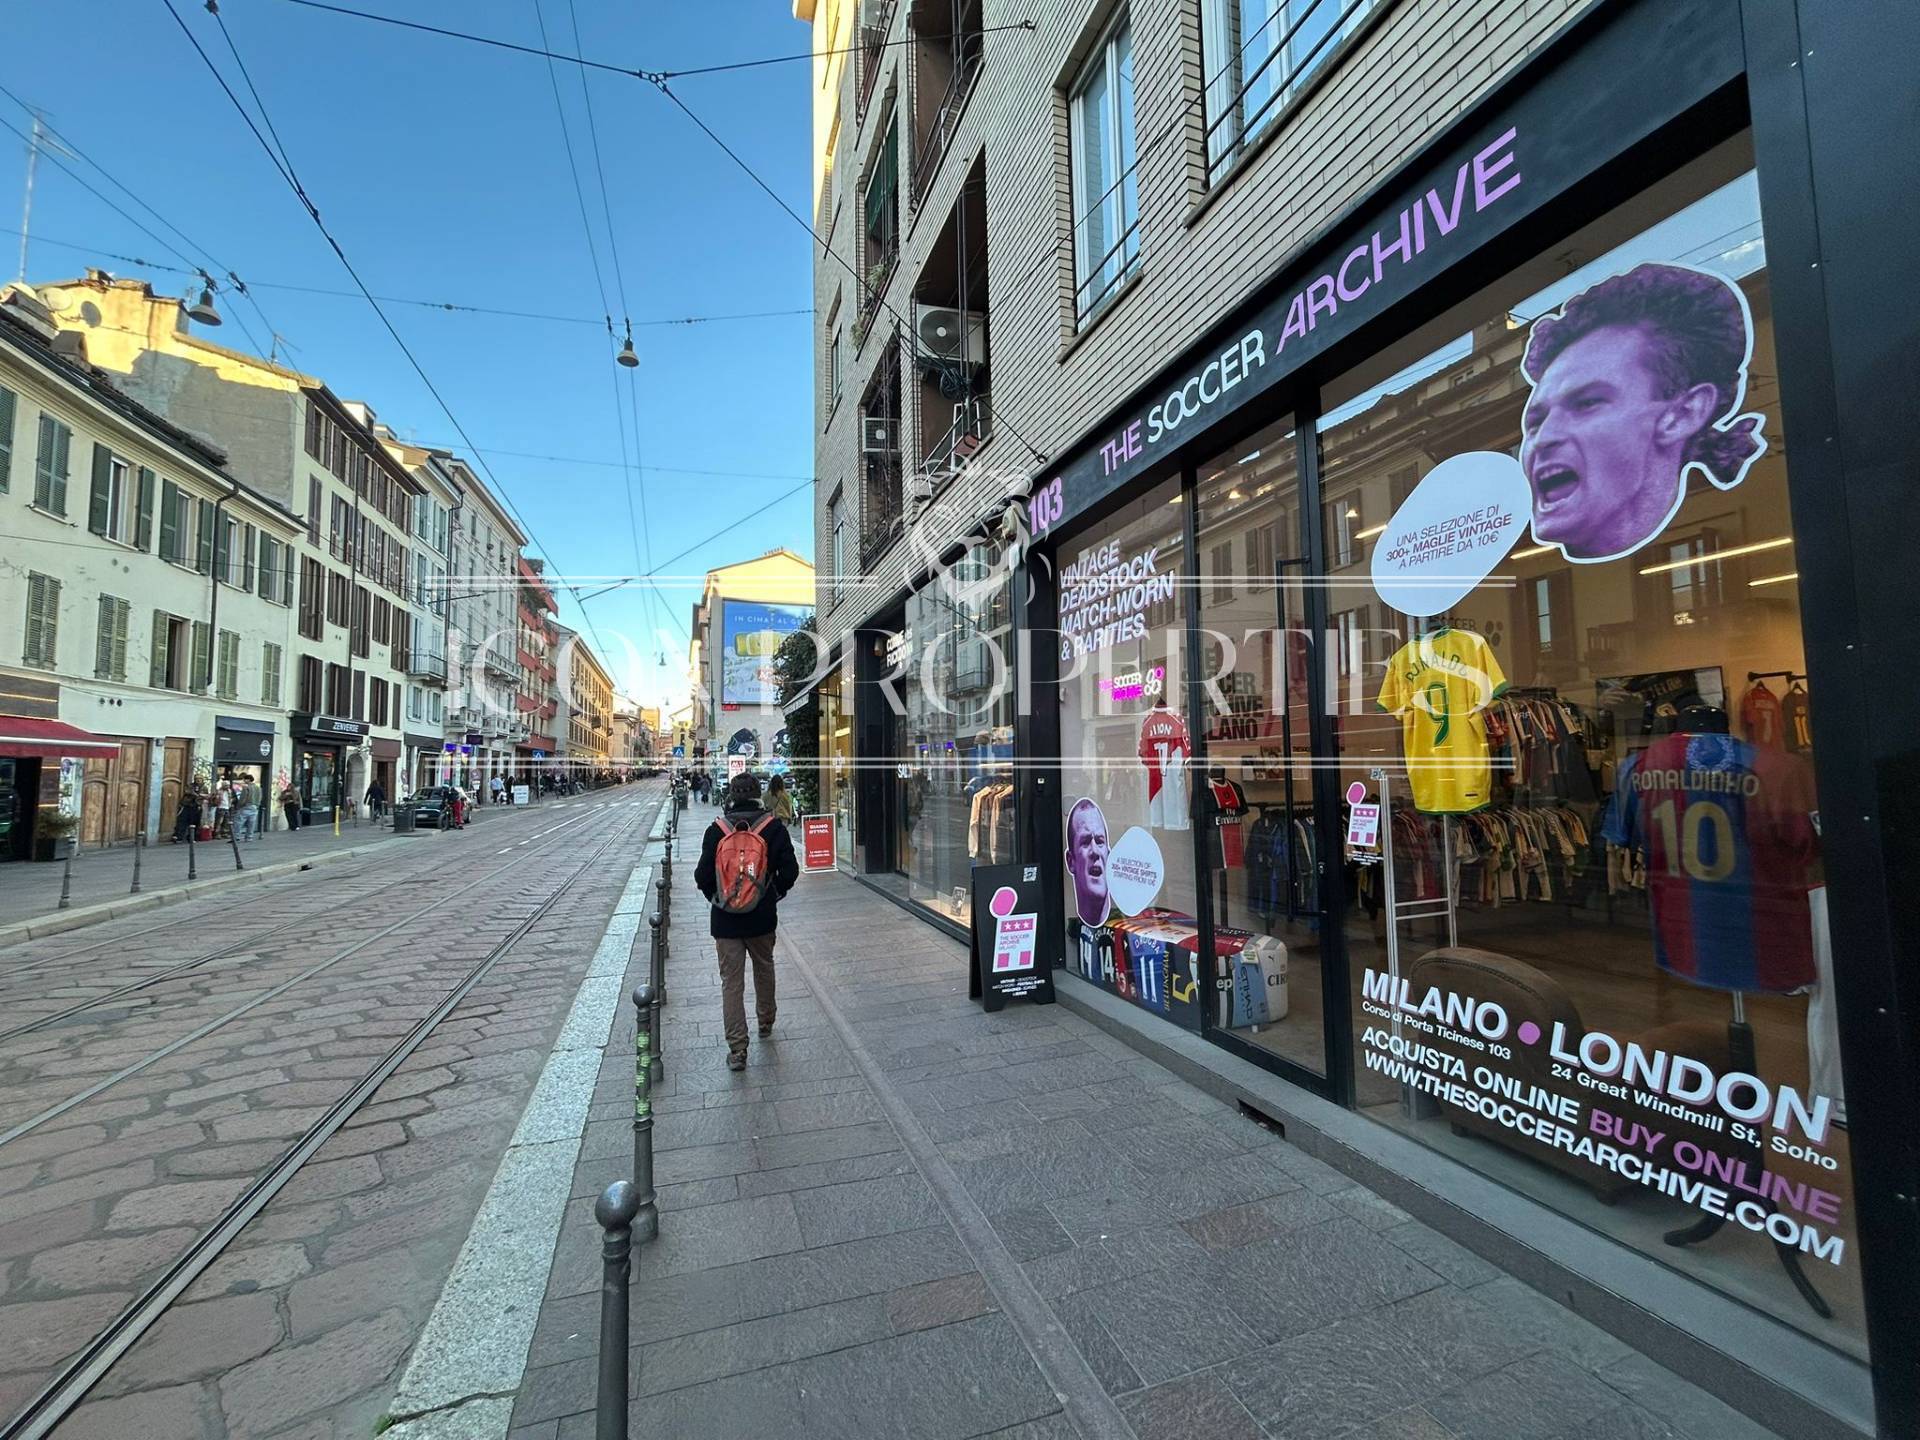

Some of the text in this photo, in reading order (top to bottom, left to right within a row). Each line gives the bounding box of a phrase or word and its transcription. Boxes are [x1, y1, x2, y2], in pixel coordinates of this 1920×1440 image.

[1100, 126, 1521, 476] THE SOCCER ARCHIVE
[1028, 477, 1063, 536] 103
[1396, 504, 1499, 547] UNA SELEZIONE DI
[1060, 538, 1120, 589] VINTAGE
[1386, 513, 1512, 562] 300+ MAGLIE VINTAGE
[1399, 530, 1500, 570] A PARTIRE DA 10€
[1060, 547, 1159, 613] DEADSTOCK
[1060, 569, 1175, 637] MATCH-WORN
[1061, 612, 1146, 661] & RARITIES
[1113, 672, 1142, 689] SOCCER
[1427, 681, 1450, 747] 9
[1632, 769, 1760, 797] RONALDINHO
[1653, 799, 1737, 883] 10
[1099, 945, 1115, 983] 14
[1140, 955, 1157, 1003] 11
[1362, 1000, 1512, 1061] Corso di Porta Ticinese 103
[1362, 967, 1509, 1041] MILANO
[1550, 1021, 1833, 1146] LONDON
[1361, 1026, 1842, 1225] ACQUISTA ONLINE BUY ONLINE
[1551, 1063, 1838, 1171] 24 Great Windmill St, Soho
[1364, 1049, 1845, 1267] WWW.THESOCCERARCHIVE.COM
